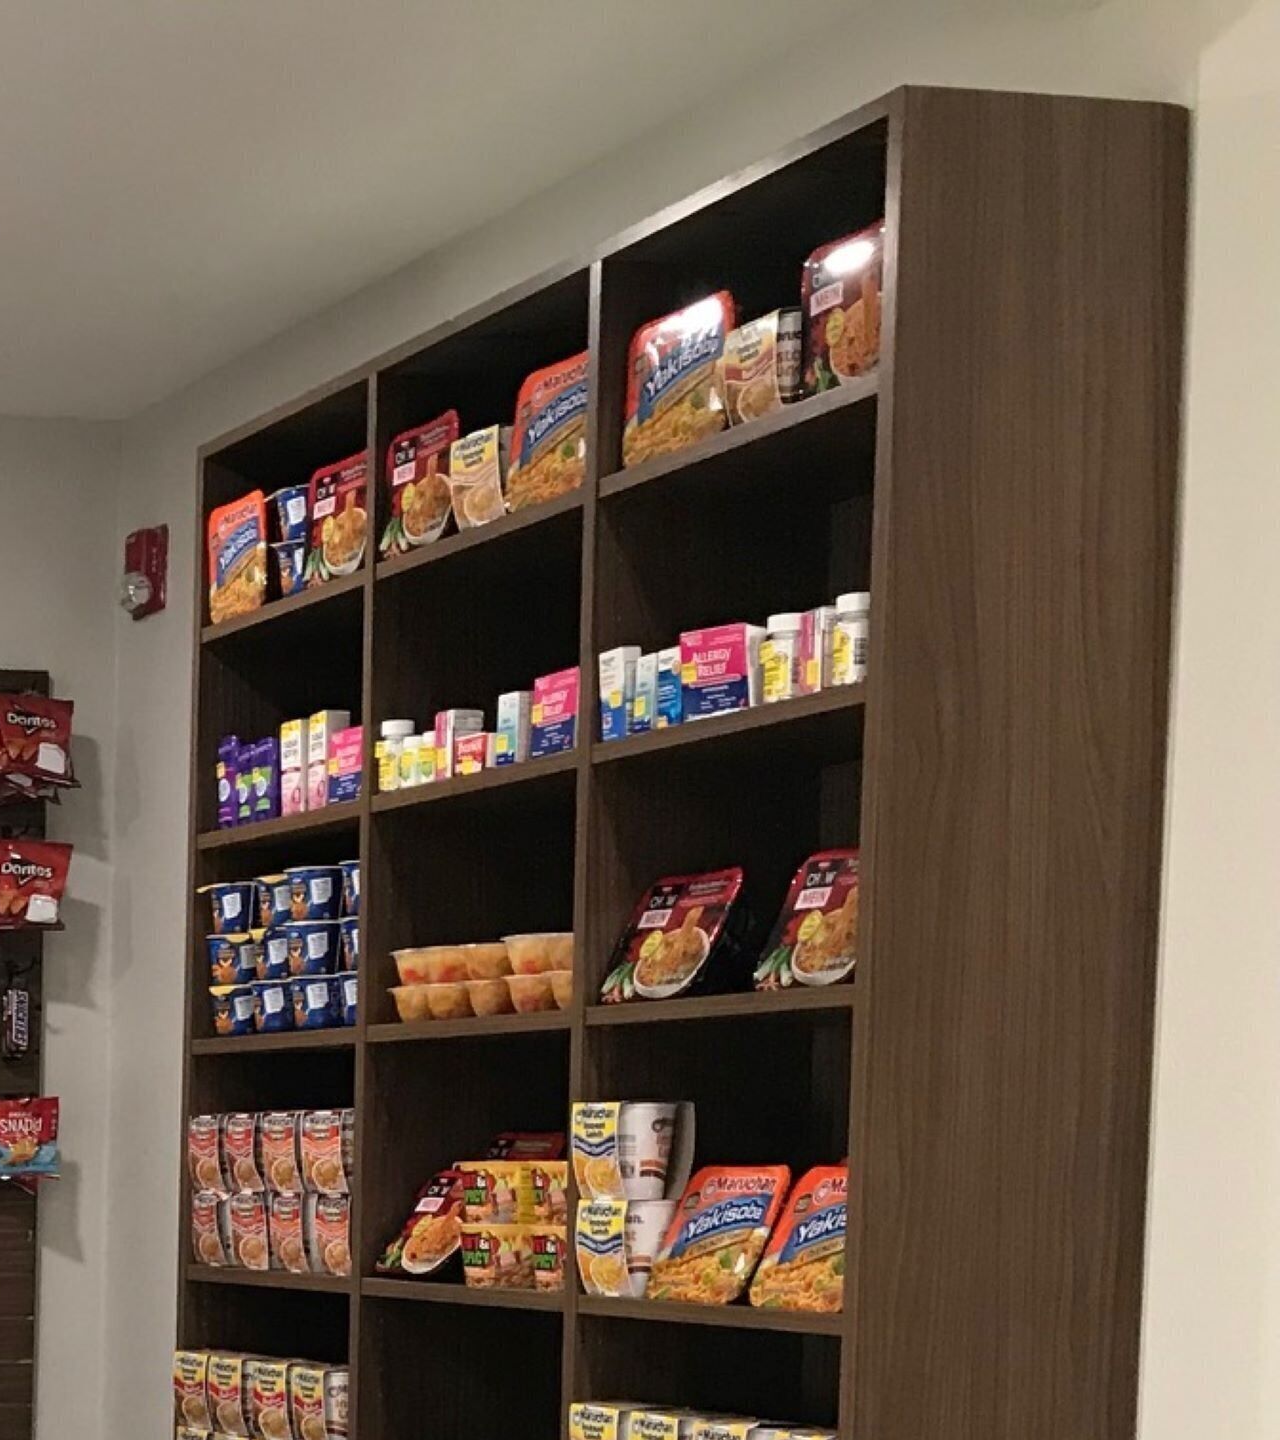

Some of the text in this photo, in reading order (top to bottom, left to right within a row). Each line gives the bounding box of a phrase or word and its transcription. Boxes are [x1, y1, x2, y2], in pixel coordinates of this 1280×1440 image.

[692, 648, 732, 663] ALLERGY
[697, 662, 727, 676] RELIEF
[6, 712, 56, 729] Doritos
[1, 861, 52, 877] Doritos
